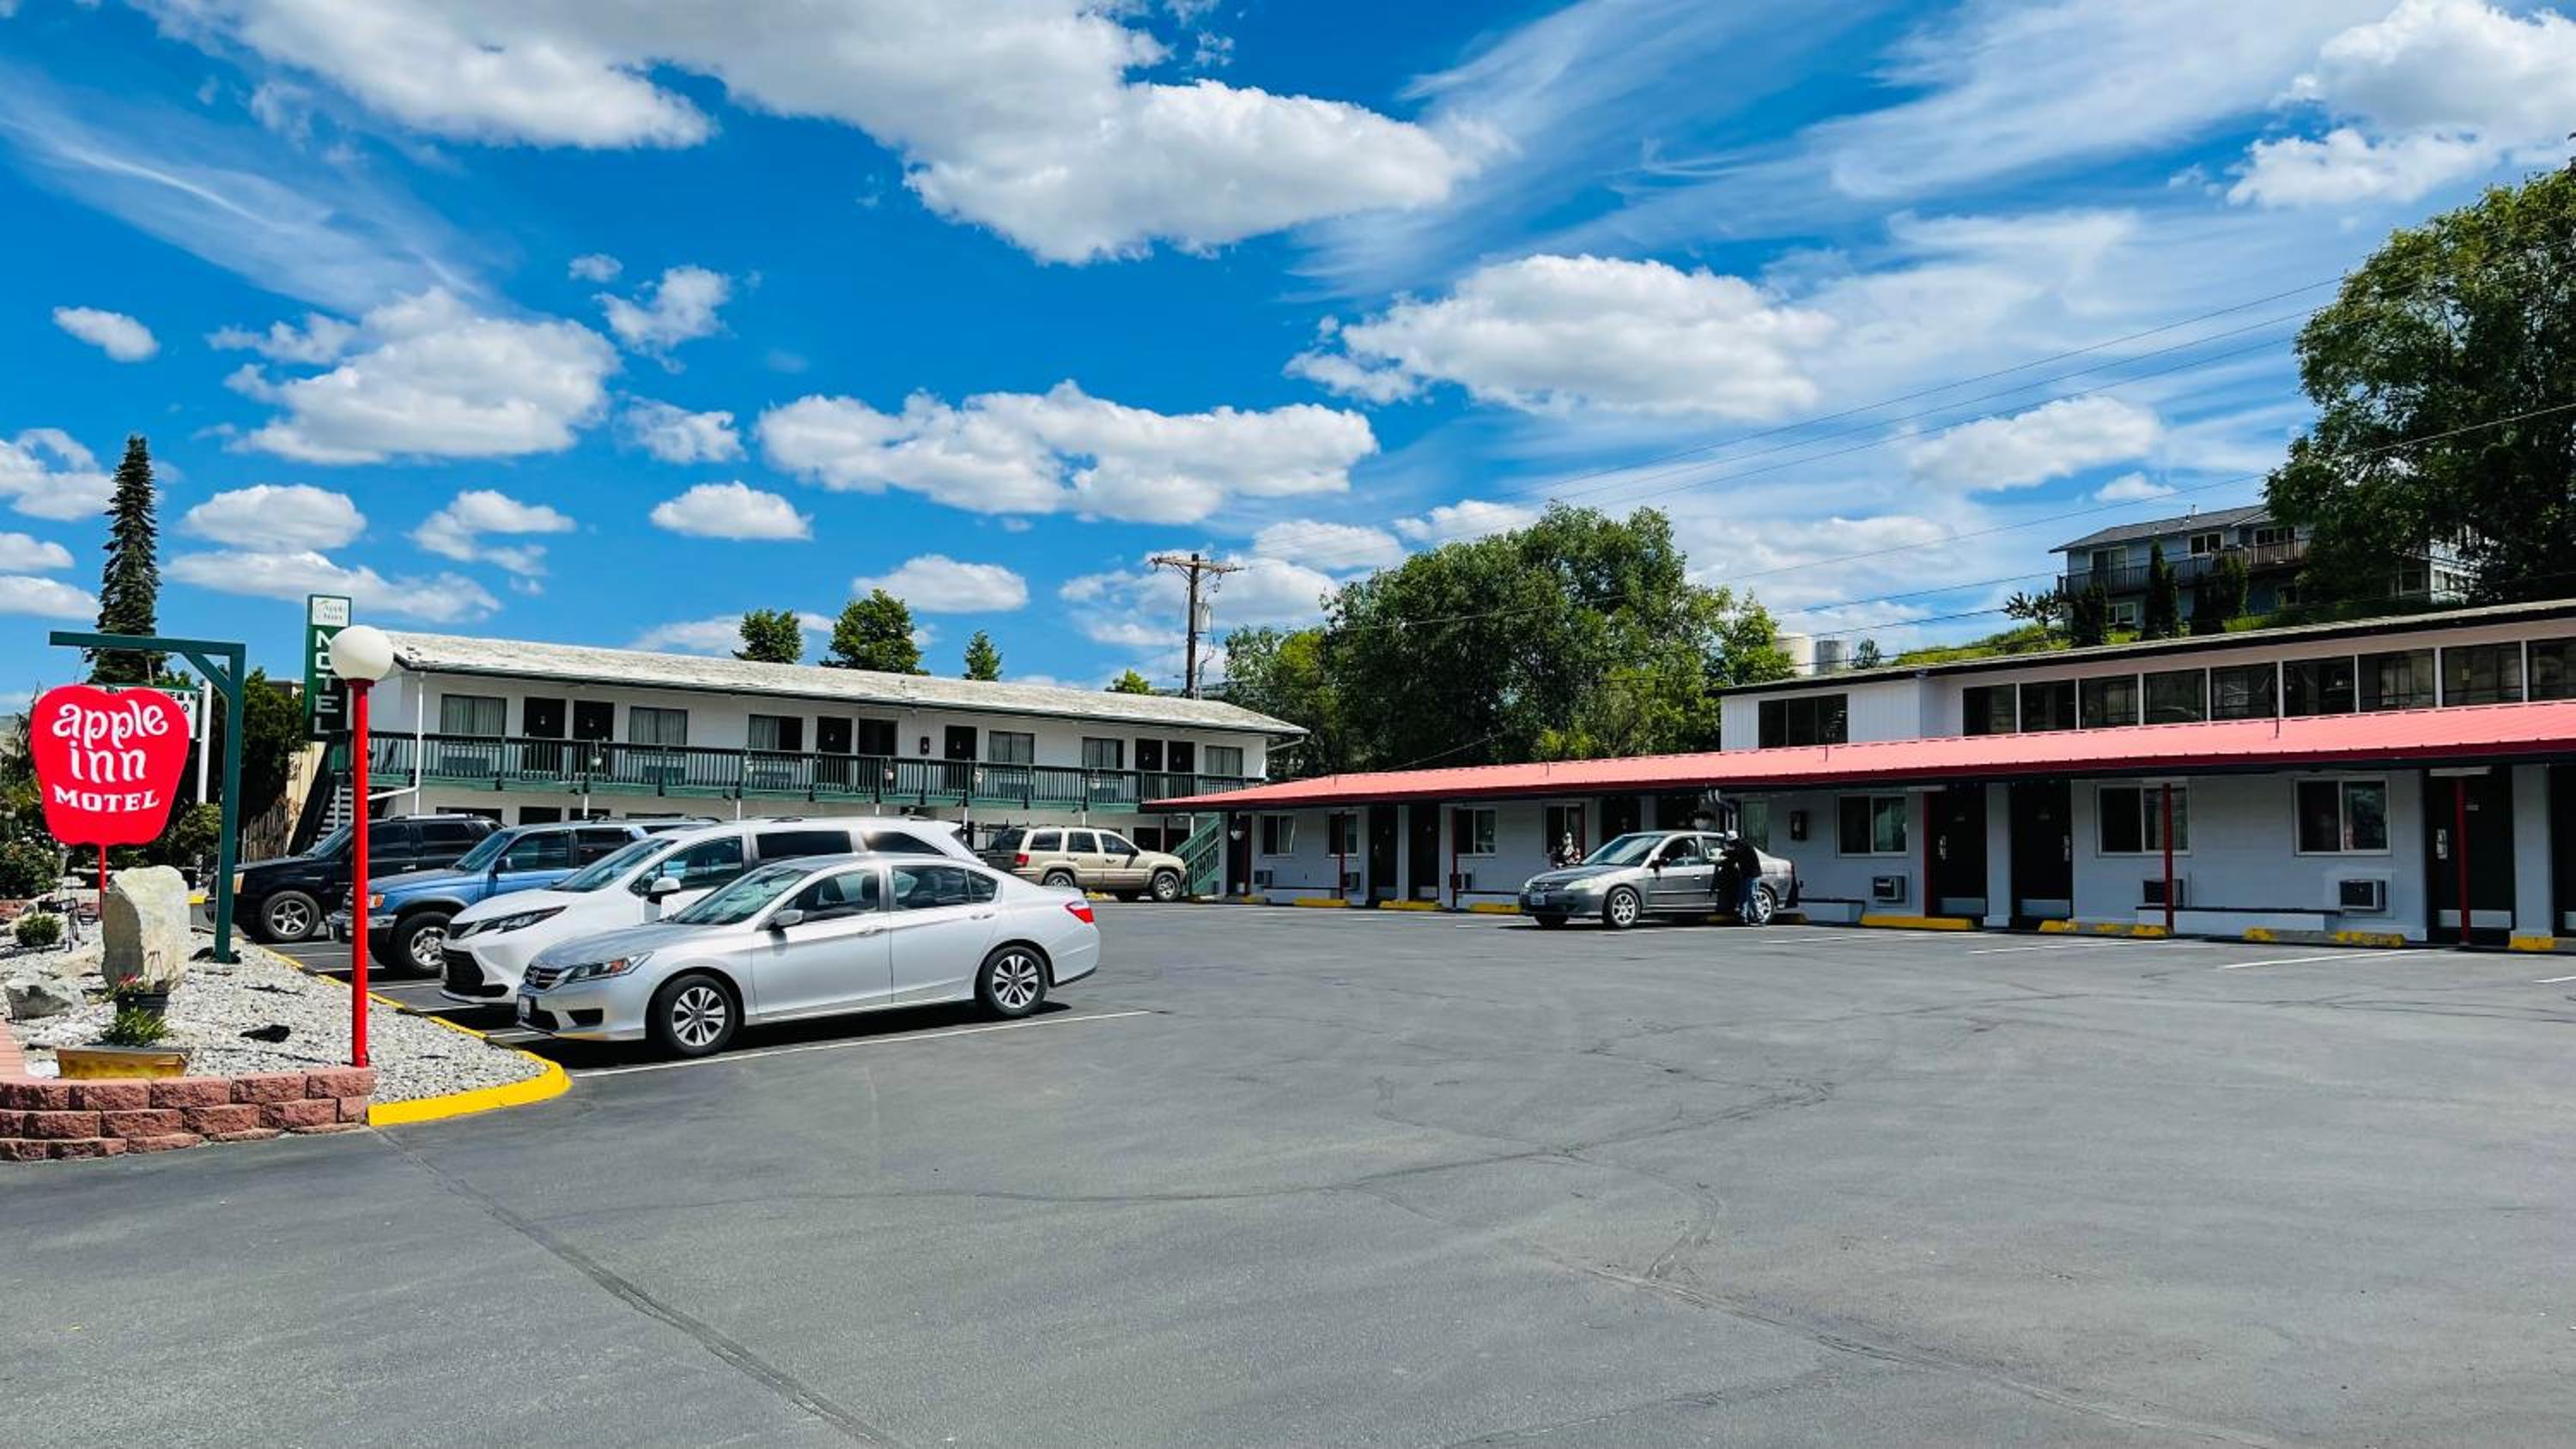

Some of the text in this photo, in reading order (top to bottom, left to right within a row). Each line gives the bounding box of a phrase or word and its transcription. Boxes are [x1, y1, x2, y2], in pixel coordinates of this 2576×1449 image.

[52, 699, 169, 749] apple
[69, 740, 147, 784] inn
[52, 782, 161, 813] MOTEL
